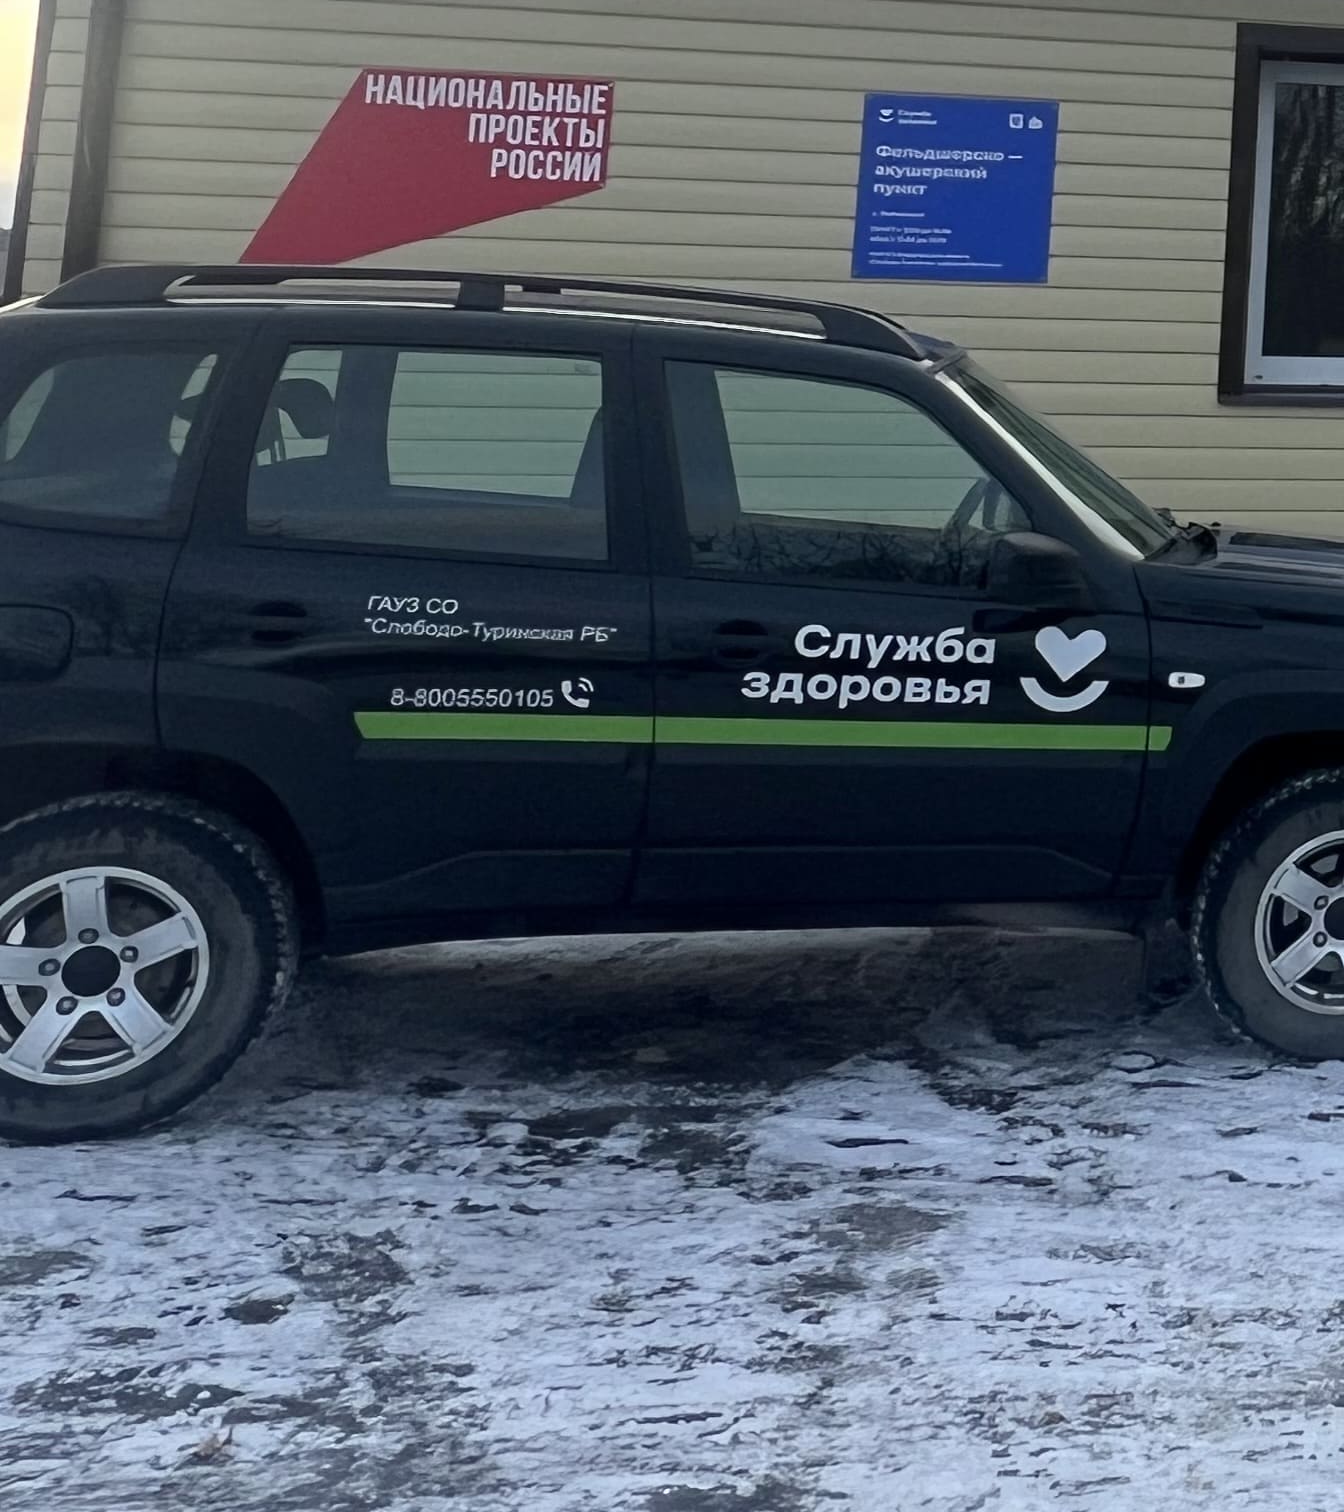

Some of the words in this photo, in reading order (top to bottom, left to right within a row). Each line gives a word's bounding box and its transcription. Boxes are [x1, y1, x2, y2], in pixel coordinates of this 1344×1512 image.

[364, 74, 609, 114] НАЦИОНАЛЬНЫЕ
[468, 113, 606, 149] ПРОЕКТЫ
[490, 148, 601, 182] РОССИИ
[874, 164, 988, 180] акушерский
[873, 183, 928, 197] пункт
[367, 595, 420, 614] ГАУЗ
[426, 598, 459, 615] СО
[794, 622, 997, 669] Служба
[390, 687, 554, 708] 8-8005550105
[739, 670, 992, 710] здоровья
